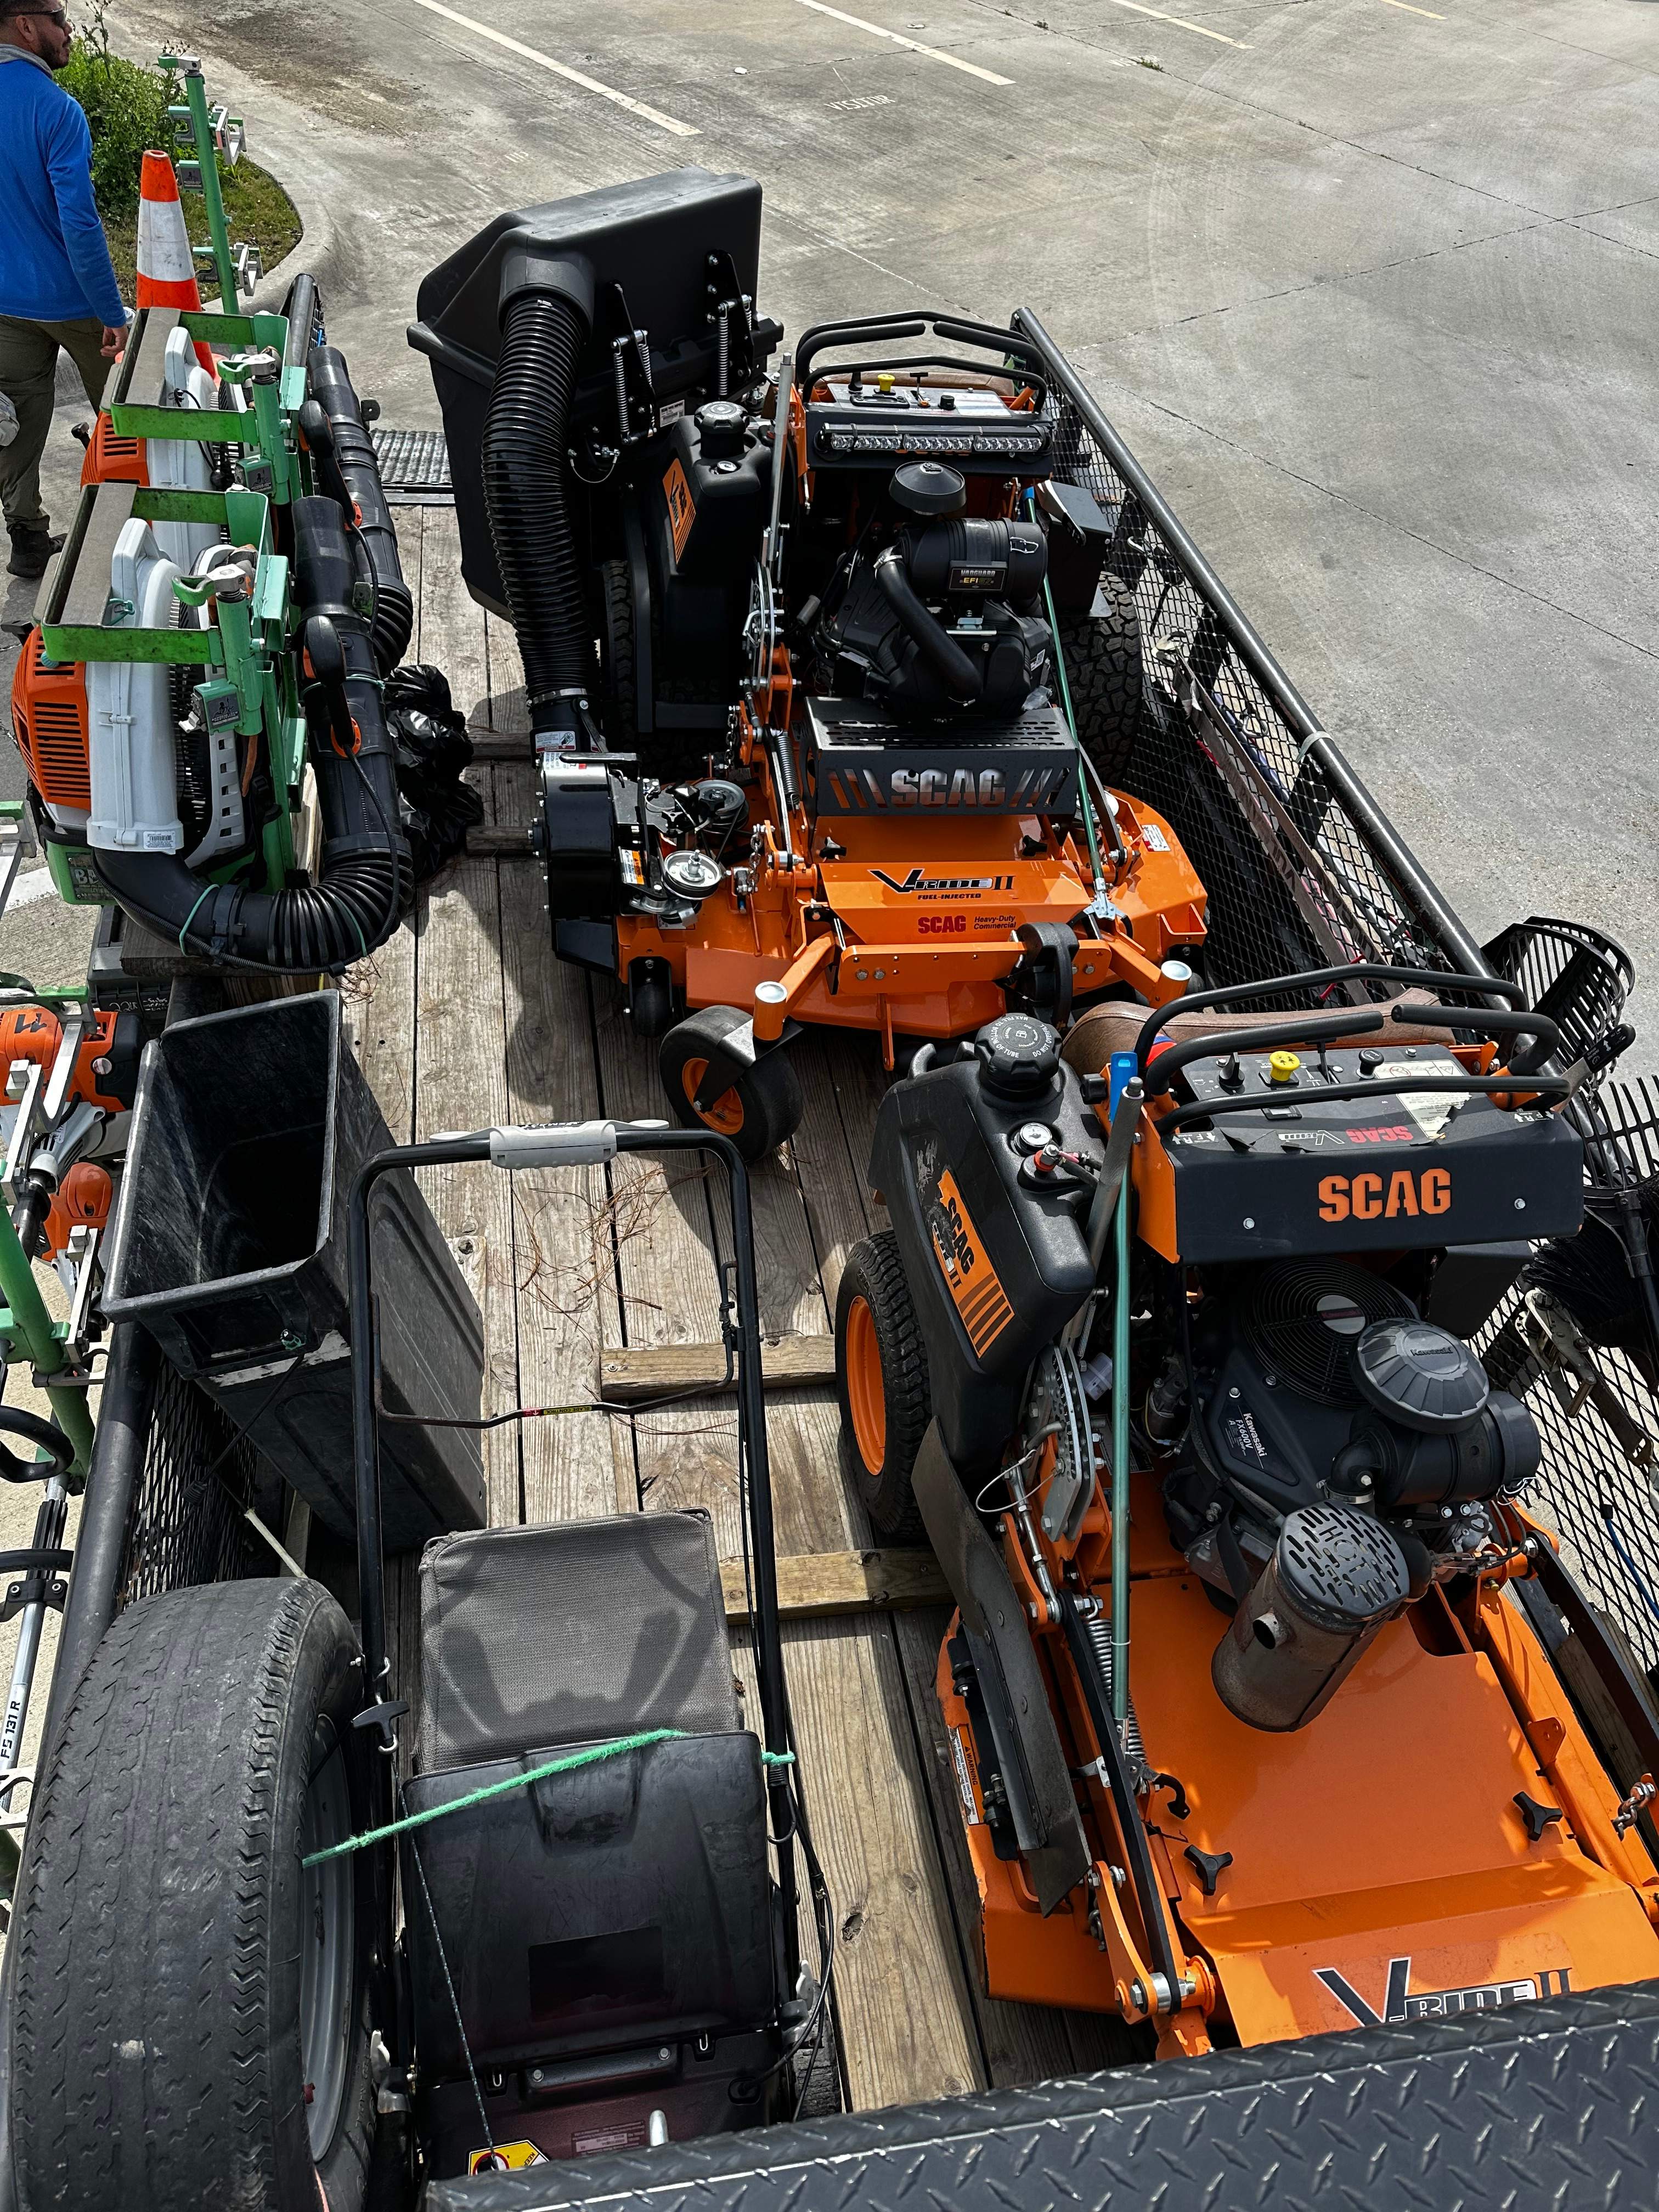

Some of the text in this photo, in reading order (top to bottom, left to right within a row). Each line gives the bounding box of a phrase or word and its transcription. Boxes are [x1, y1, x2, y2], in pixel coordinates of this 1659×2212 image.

[823, 95, 895, 110] VISITOR
[891, 769, 1006, 808] SCAG
[918, 915, 966, 934] SCAG
[974, 915, 1016, 923] Heavy-Duty
[990, 1026, 1000, 1045] BOTTOM
[1003, 1048, 1020, 1058] TUBE
[1040, 1043, 1051, 1053] NOT
[1346, 1126, 1414, 1144] SCAG
[1318, 1169, 1451, 1222] SCAG
[949, 1197, 974, 1275] SCAG
[1410, 1347, 1453, 1356] Kawasaki
[1235, 1419, 1254, 1449] FX600V
[1243, 1413, 1267, 1457] Kawasaki
[1319, 1526, 1372, 1573] HOT
[1, 1701, 20, 1759] FS 131 R
[967, 1752, 978, 1786] WARNING
